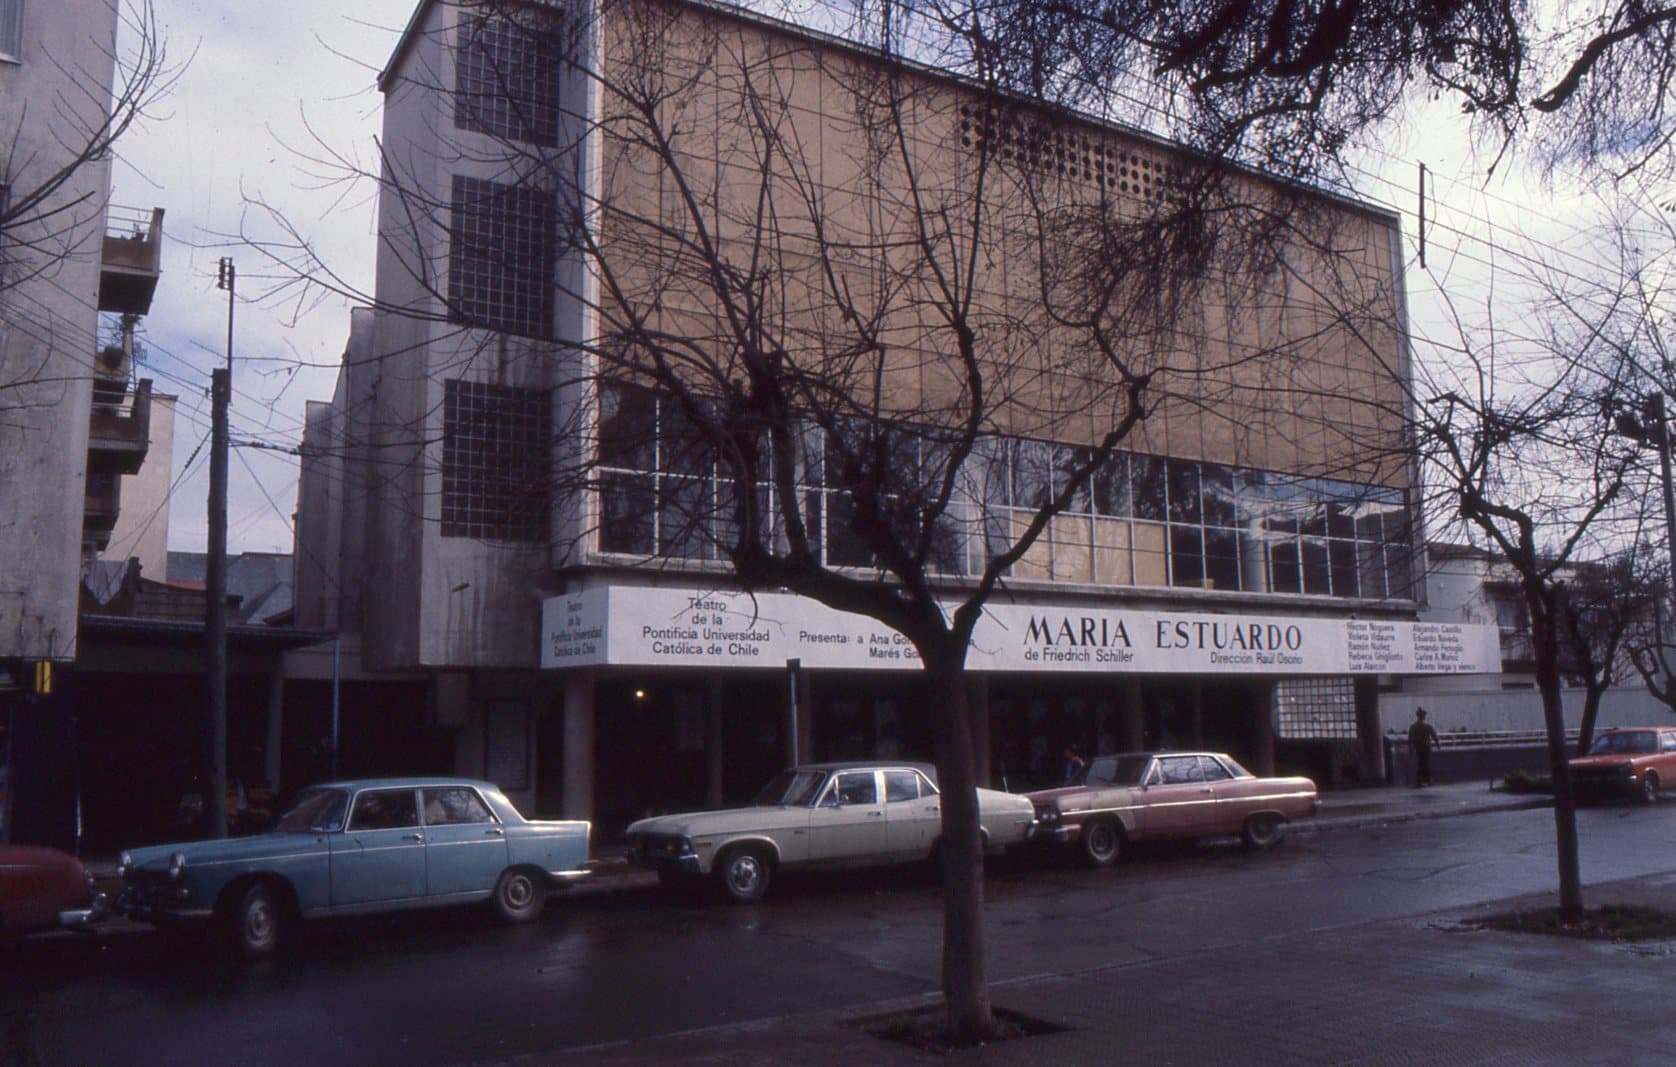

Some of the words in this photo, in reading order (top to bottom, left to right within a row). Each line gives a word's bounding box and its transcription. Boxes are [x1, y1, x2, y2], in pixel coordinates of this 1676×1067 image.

[687, 597, 727, 611] Teatro
[691, 613, 707, 625] de
[712, 613, 723, 625] la
[642, 625, 698, 640] Pontificia
[703, 628, 770, 642] Universidad
[1023, 615, 1132, 648] MARIA
[1155, 620, 1303, 651] ESTUARDO
[856, 635, 864, 644] a
[869, 633, 890, 645] Ana
[652, 641, 704, 655] Católica
[706, 643, 723, 655] de
[728, 642, 760, 656] Chile
[869, 646, 900, 659] Marés
[1024, 647, 1039, 661] de
[1043, 647, 1091, 662] Friedrich
[1095, 648, 1134, 663] Schiller
[1276, 652, 1304, 665] Osorio
